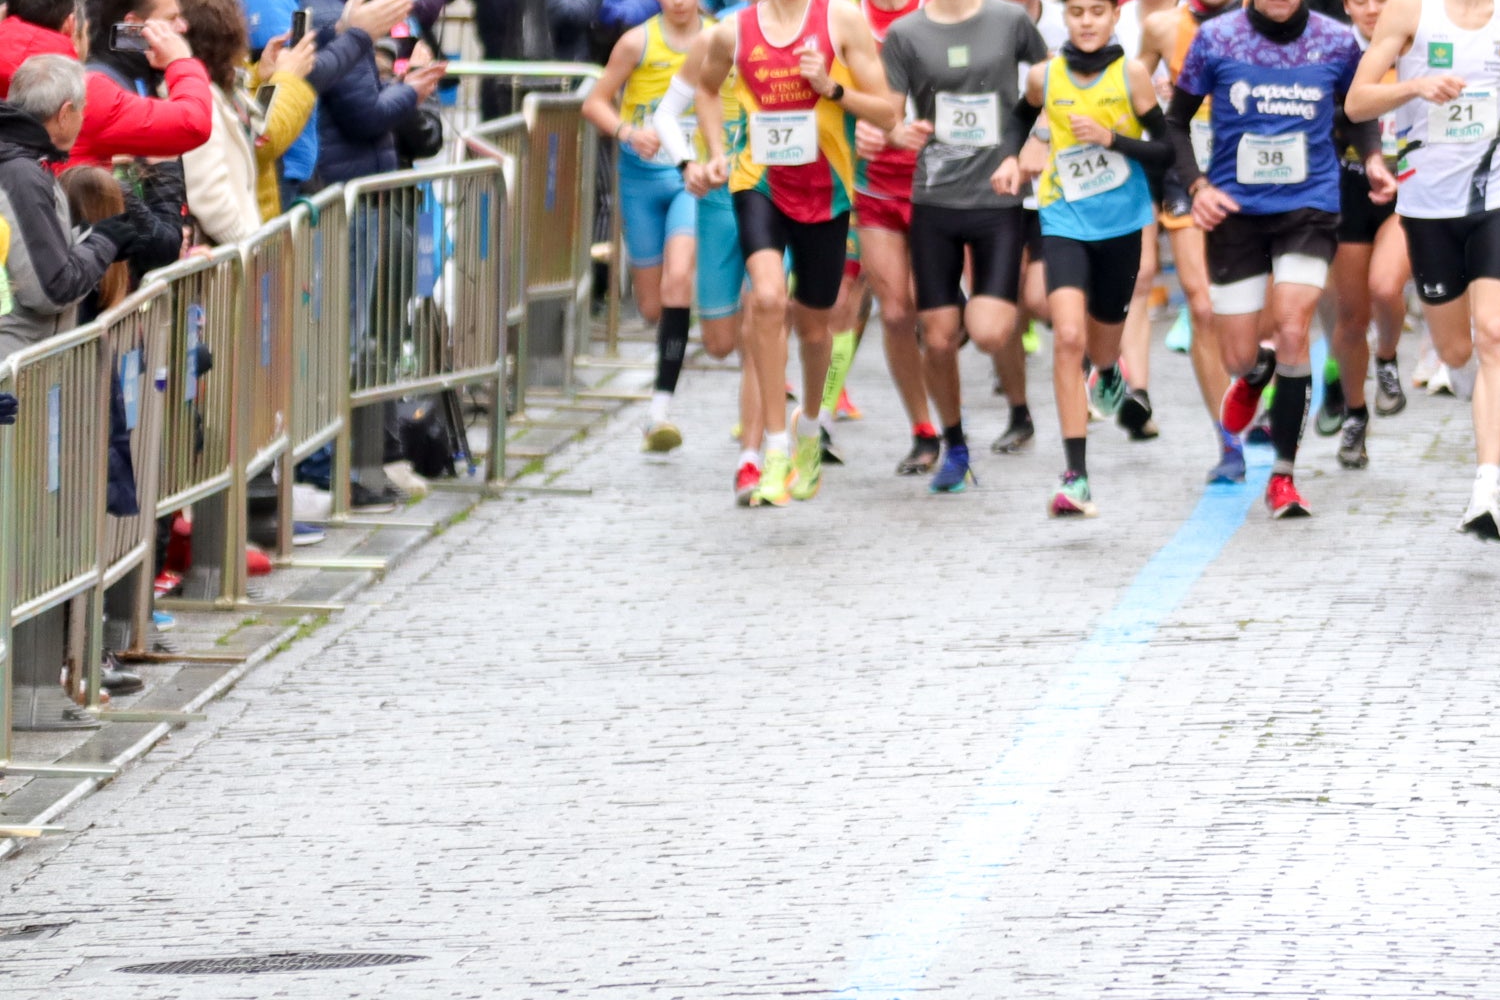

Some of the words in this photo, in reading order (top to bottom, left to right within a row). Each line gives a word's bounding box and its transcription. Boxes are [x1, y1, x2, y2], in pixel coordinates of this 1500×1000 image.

[952, 109, 977, 127] 20
[1448, 104, 1474, 122] 21
[767, 127, 793, 145] 37
[1068, 154, 1109, 179] 214
[1257, 150, 1283, 165] 38
